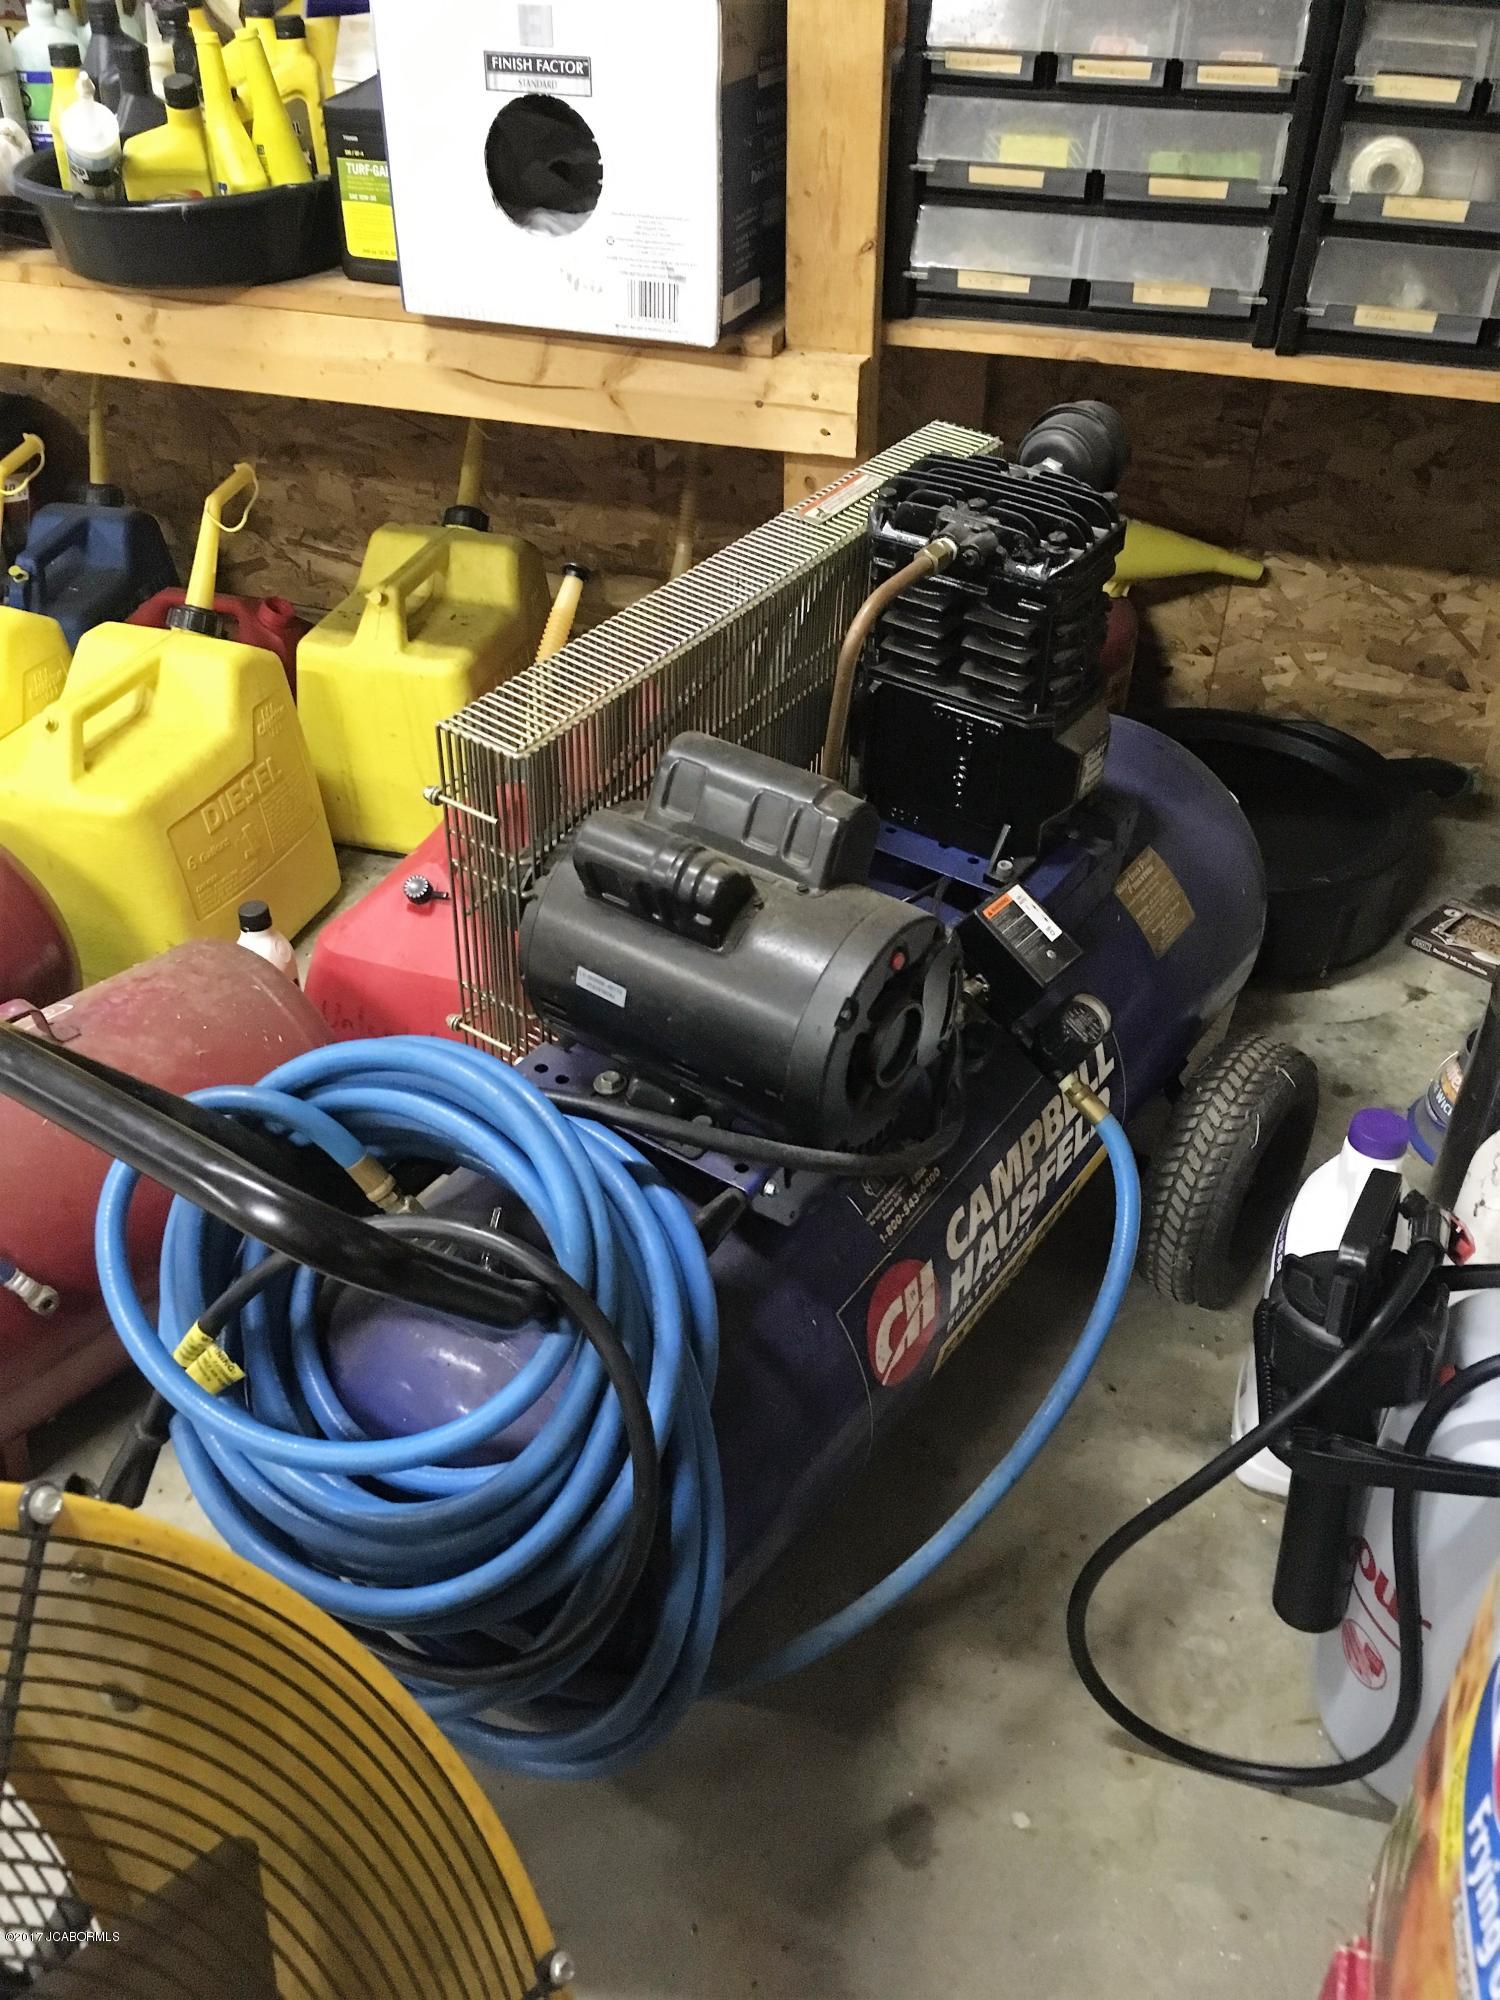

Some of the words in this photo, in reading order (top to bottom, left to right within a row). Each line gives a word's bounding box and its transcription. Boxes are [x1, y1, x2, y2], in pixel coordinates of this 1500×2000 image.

[491, 56, 533, 71] FINISH
[518, 78, 558, 90] STANDARD
[200, 756, 283, 836] DIESEL
